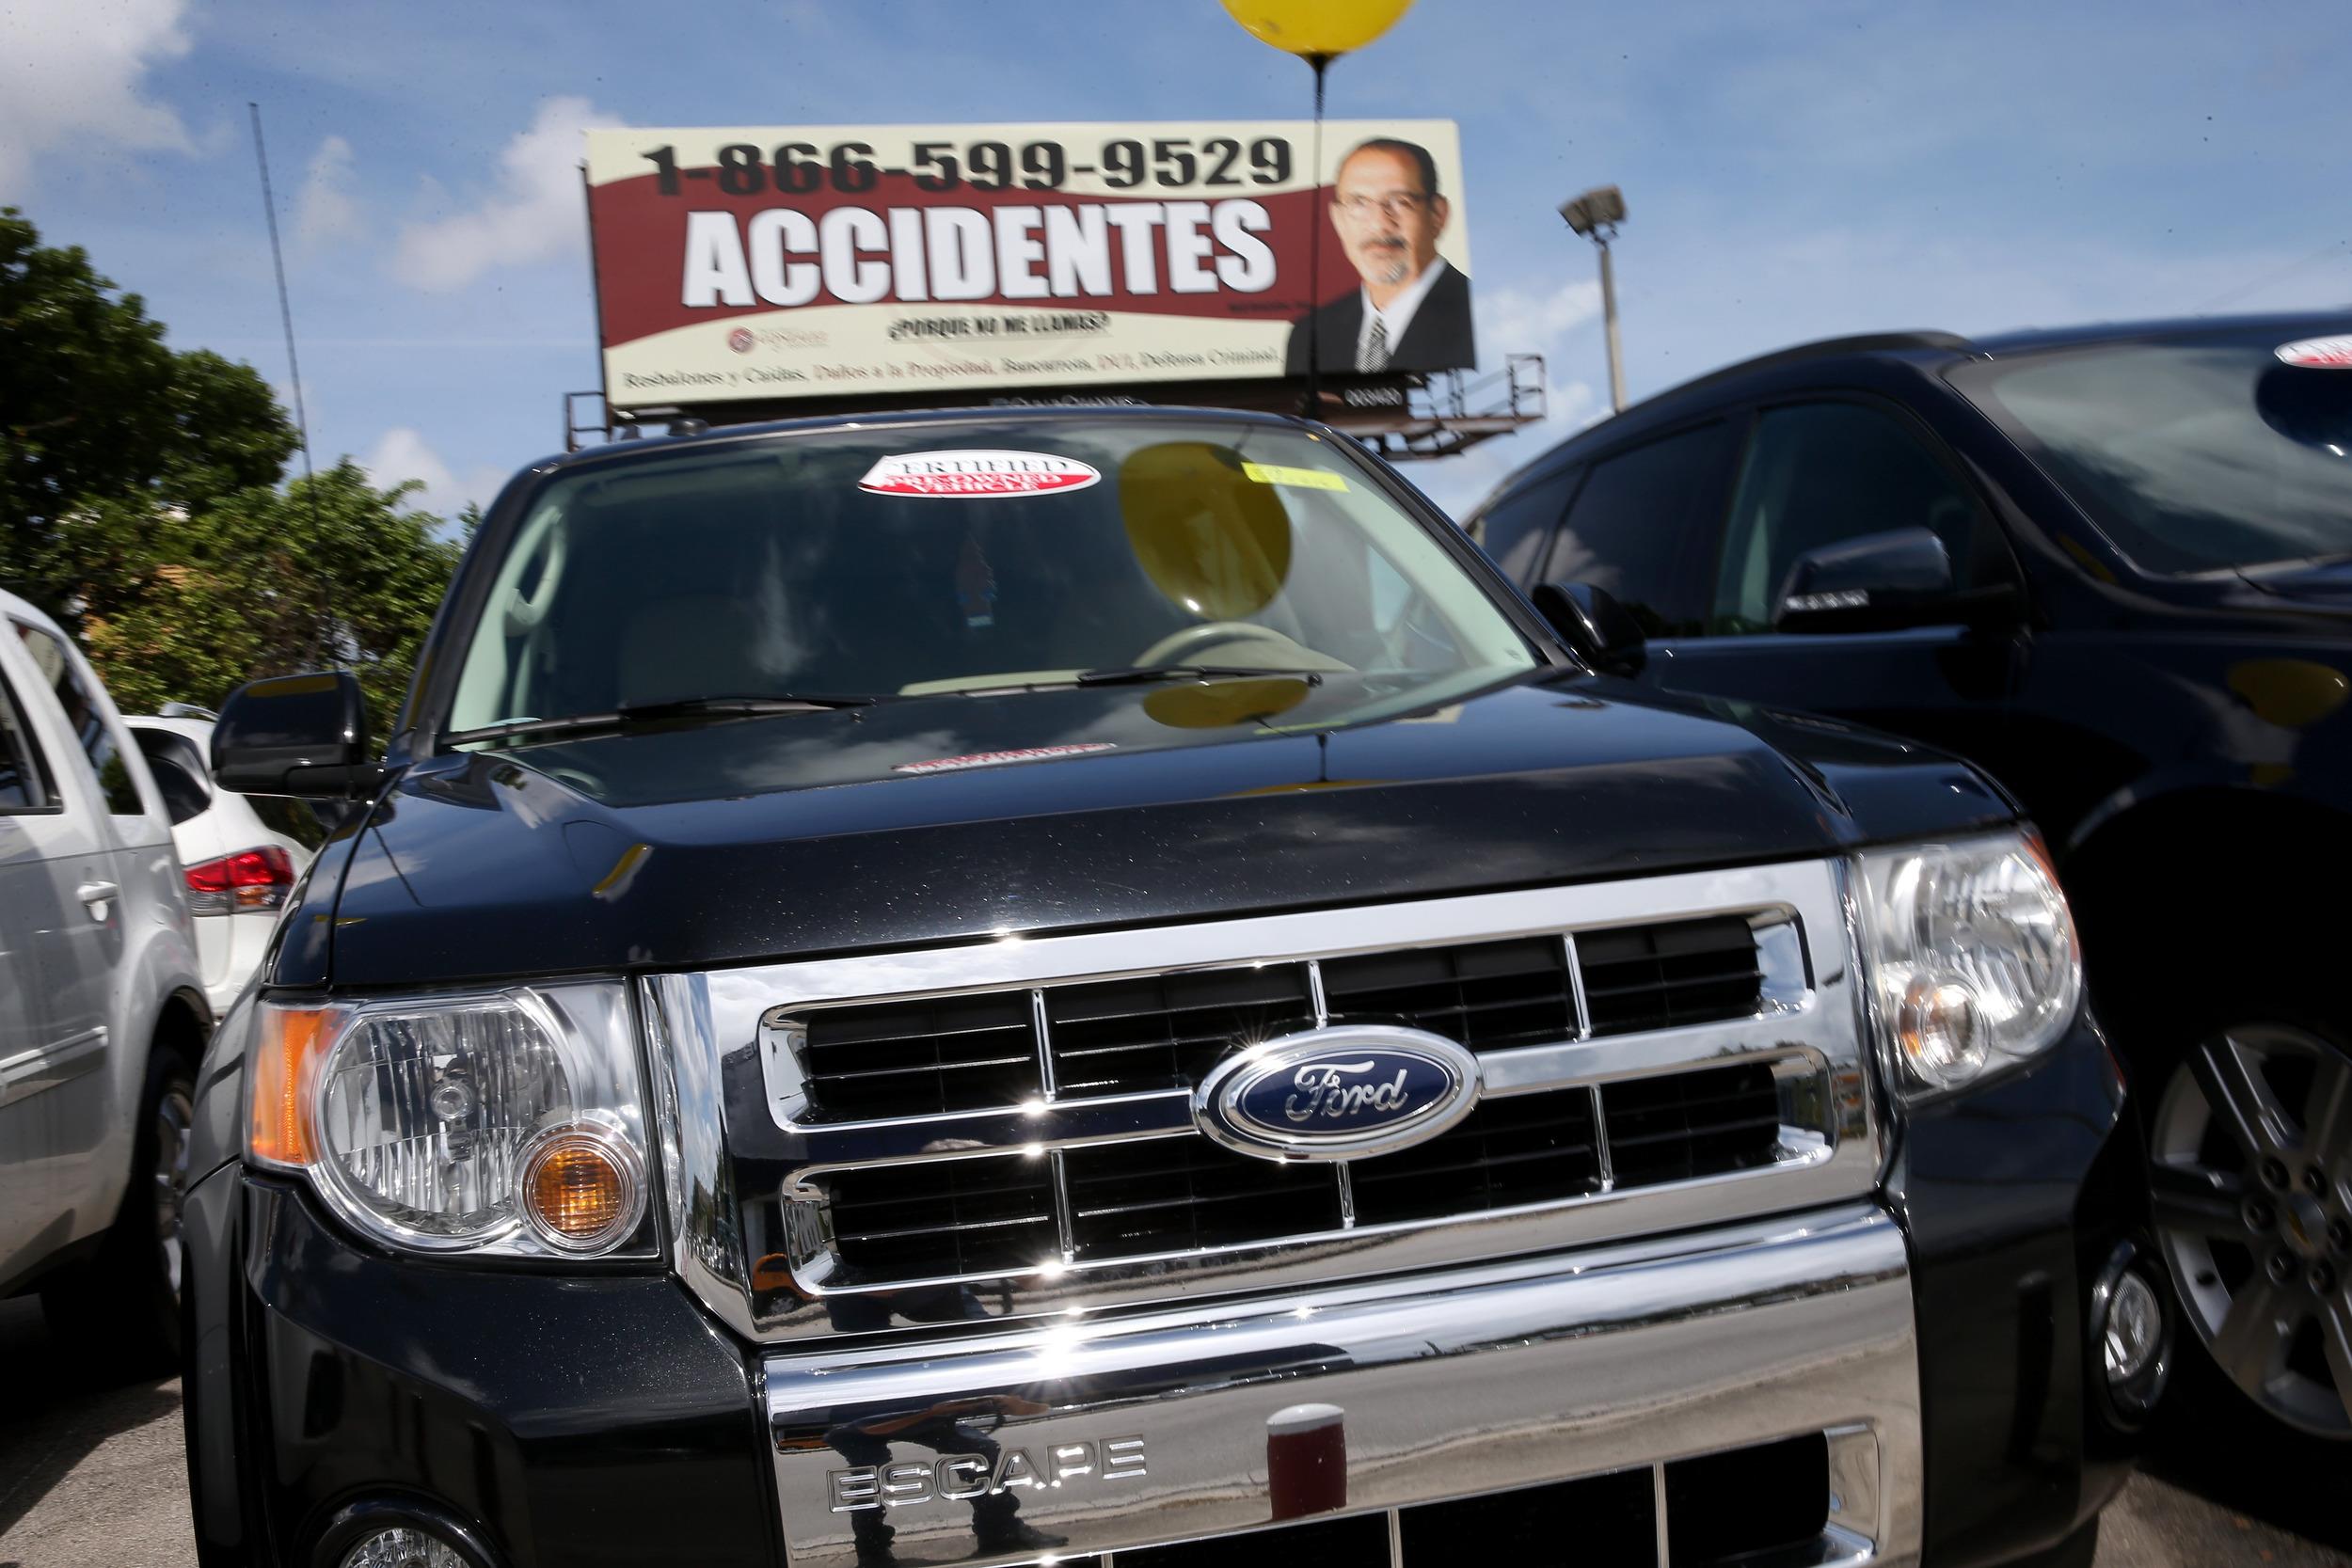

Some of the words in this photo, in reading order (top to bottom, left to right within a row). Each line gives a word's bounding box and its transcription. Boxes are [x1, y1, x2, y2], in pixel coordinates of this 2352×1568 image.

[641, 138, 1292, 195] 1-866-599-9529
[681, 198, 1278, 307] ACCIDENTES
[972, 315, 997, 335] NO
[1002, 314, 1029, 334] ME
[908, 480, 1040, 493] VEHICLE
[1285, 1060, 1409, 1122] Ford
[826, 1433, 1148, 1513] ESCAPE
